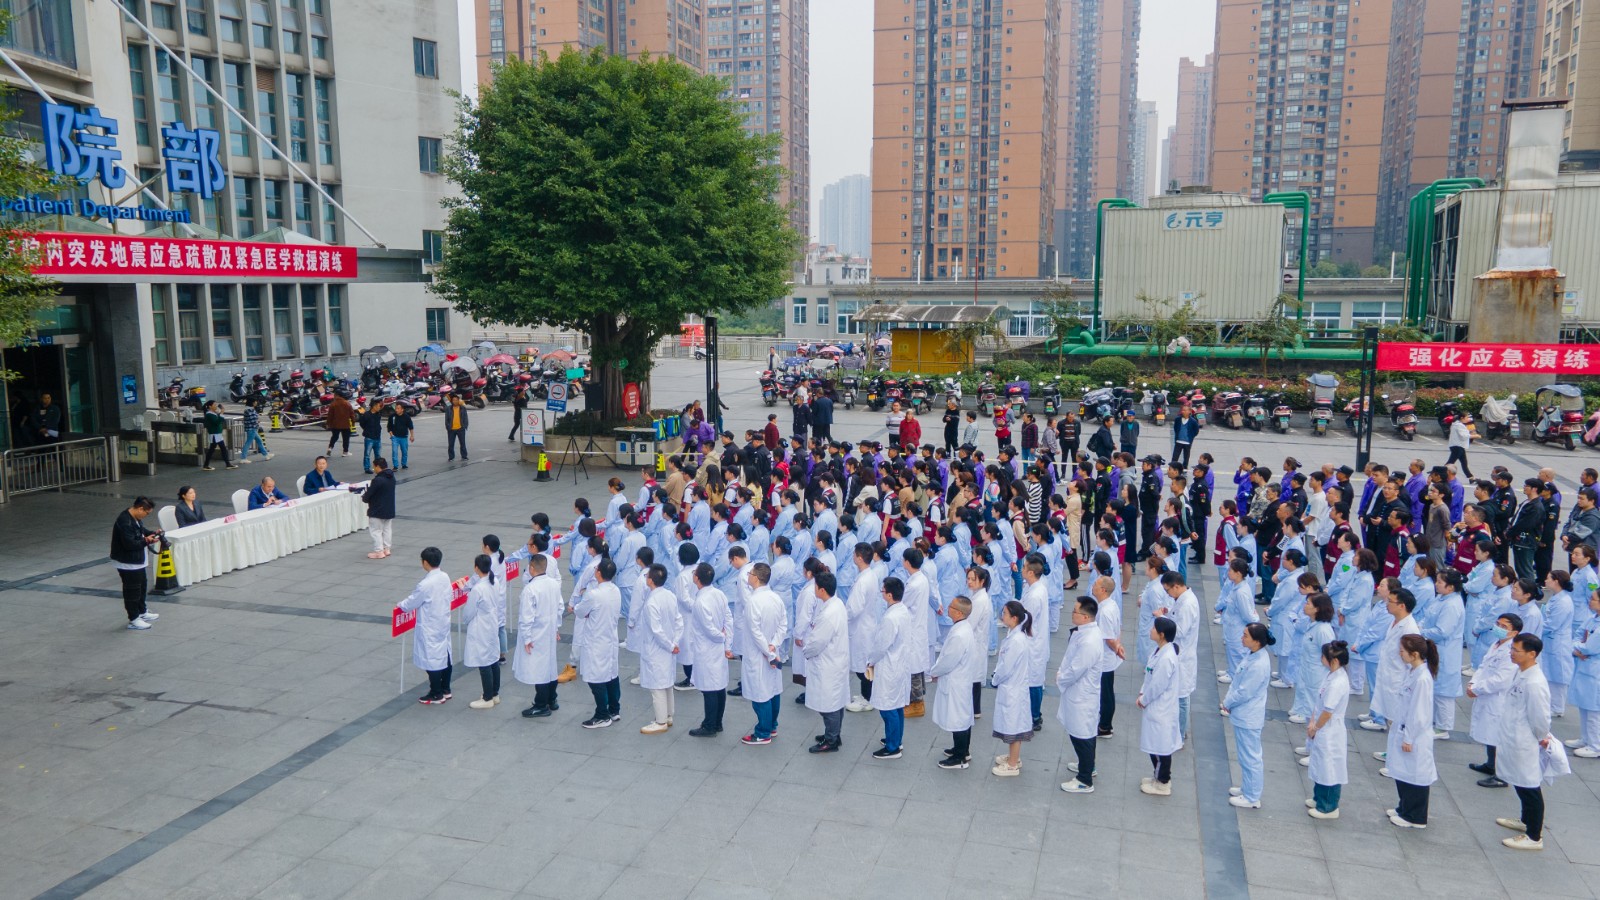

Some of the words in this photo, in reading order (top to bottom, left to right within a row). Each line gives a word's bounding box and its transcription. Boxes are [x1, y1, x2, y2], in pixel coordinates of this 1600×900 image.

[41, 101, 226, 200] 院部
[79, 198, 192, 223] Department
[1185, 211, 1224, 228] 元亨
[1409, 347, 1590, 369] 强化应急演练
